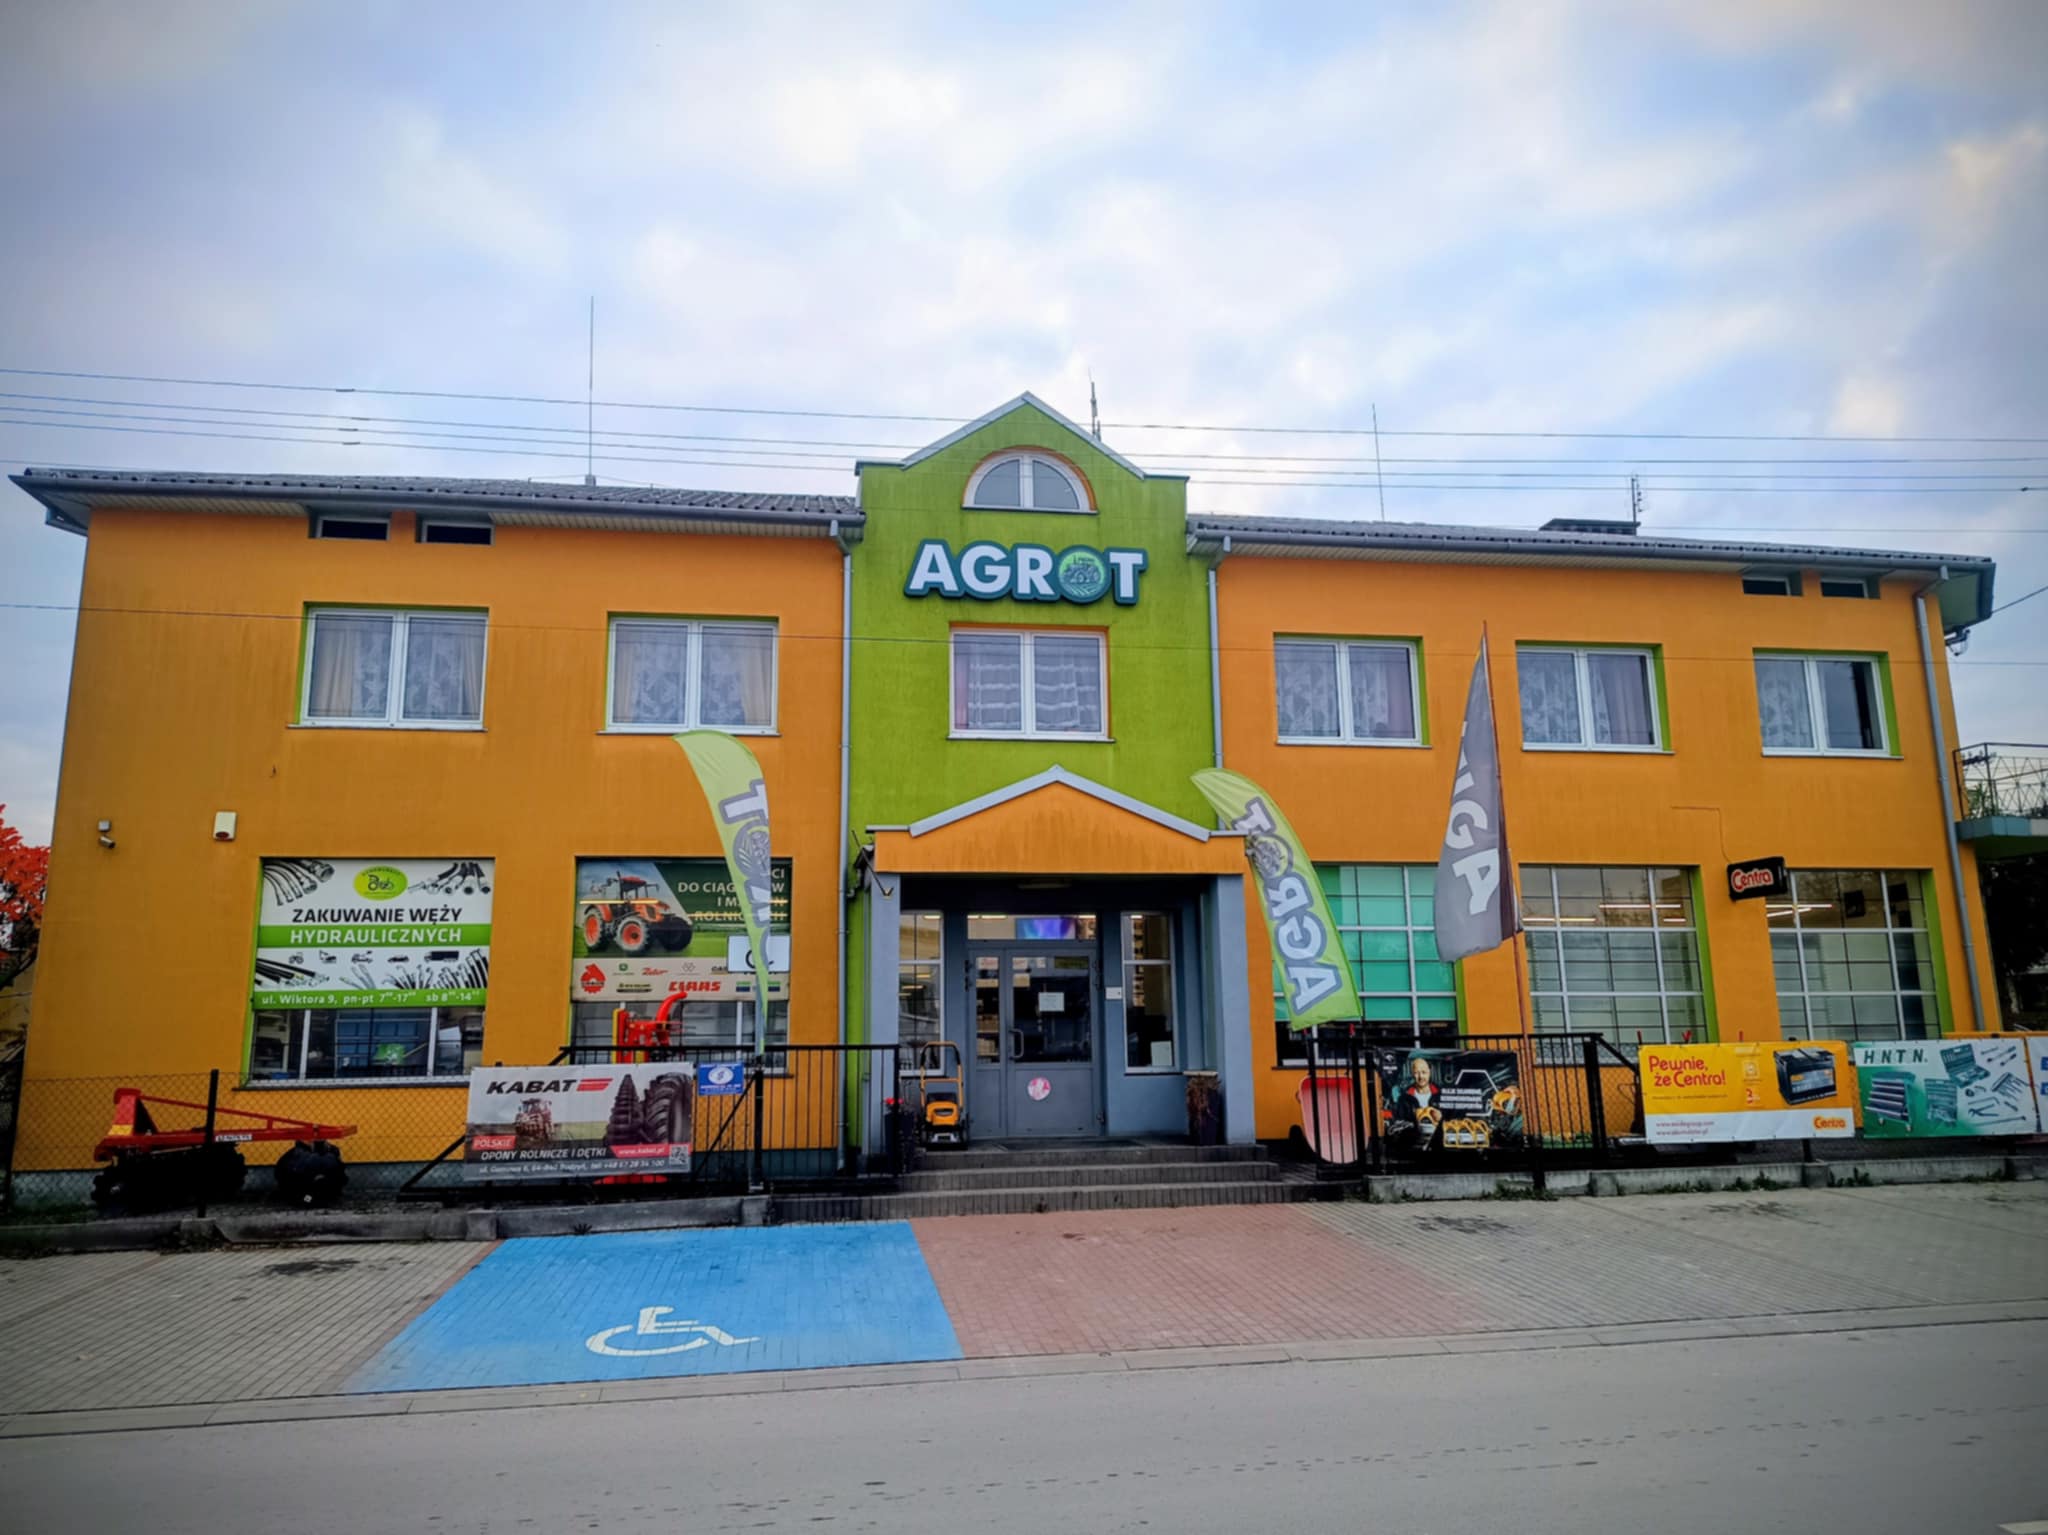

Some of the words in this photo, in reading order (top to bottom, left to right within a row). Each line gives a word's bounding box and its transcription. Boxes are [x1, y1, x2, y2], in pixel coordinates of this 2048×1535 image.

[905, 540, 1146, 604] AGROT
[678, 882, 700, 893] DO
[1731, 869, 1773, 892] Centra
[292, 908, 404, 923] ZAKUWANIE
[410, 905, 463, 925] WĘŻY
[290, 928, 462, 944] HYDRAULICZNYCH
[262, 995, 276, 1005] ul.
[280, 994, 325, 1004] Wiktora
[1648, 1055, 1708, 1072] Pewnie,
[1654, 1072, 1671, 1087] że
[1673, 1069, 1726, 1088] Centra!
[486, 1079, 577, 1095] KABAT
[474, 1137, 514, 1148] POLSKIE
[481, 1150, 517, 1160] OPONY
[519, 1149, 568, 1159] ROLNICZE
[577, 1147, 606, 1159] DĘTKI
